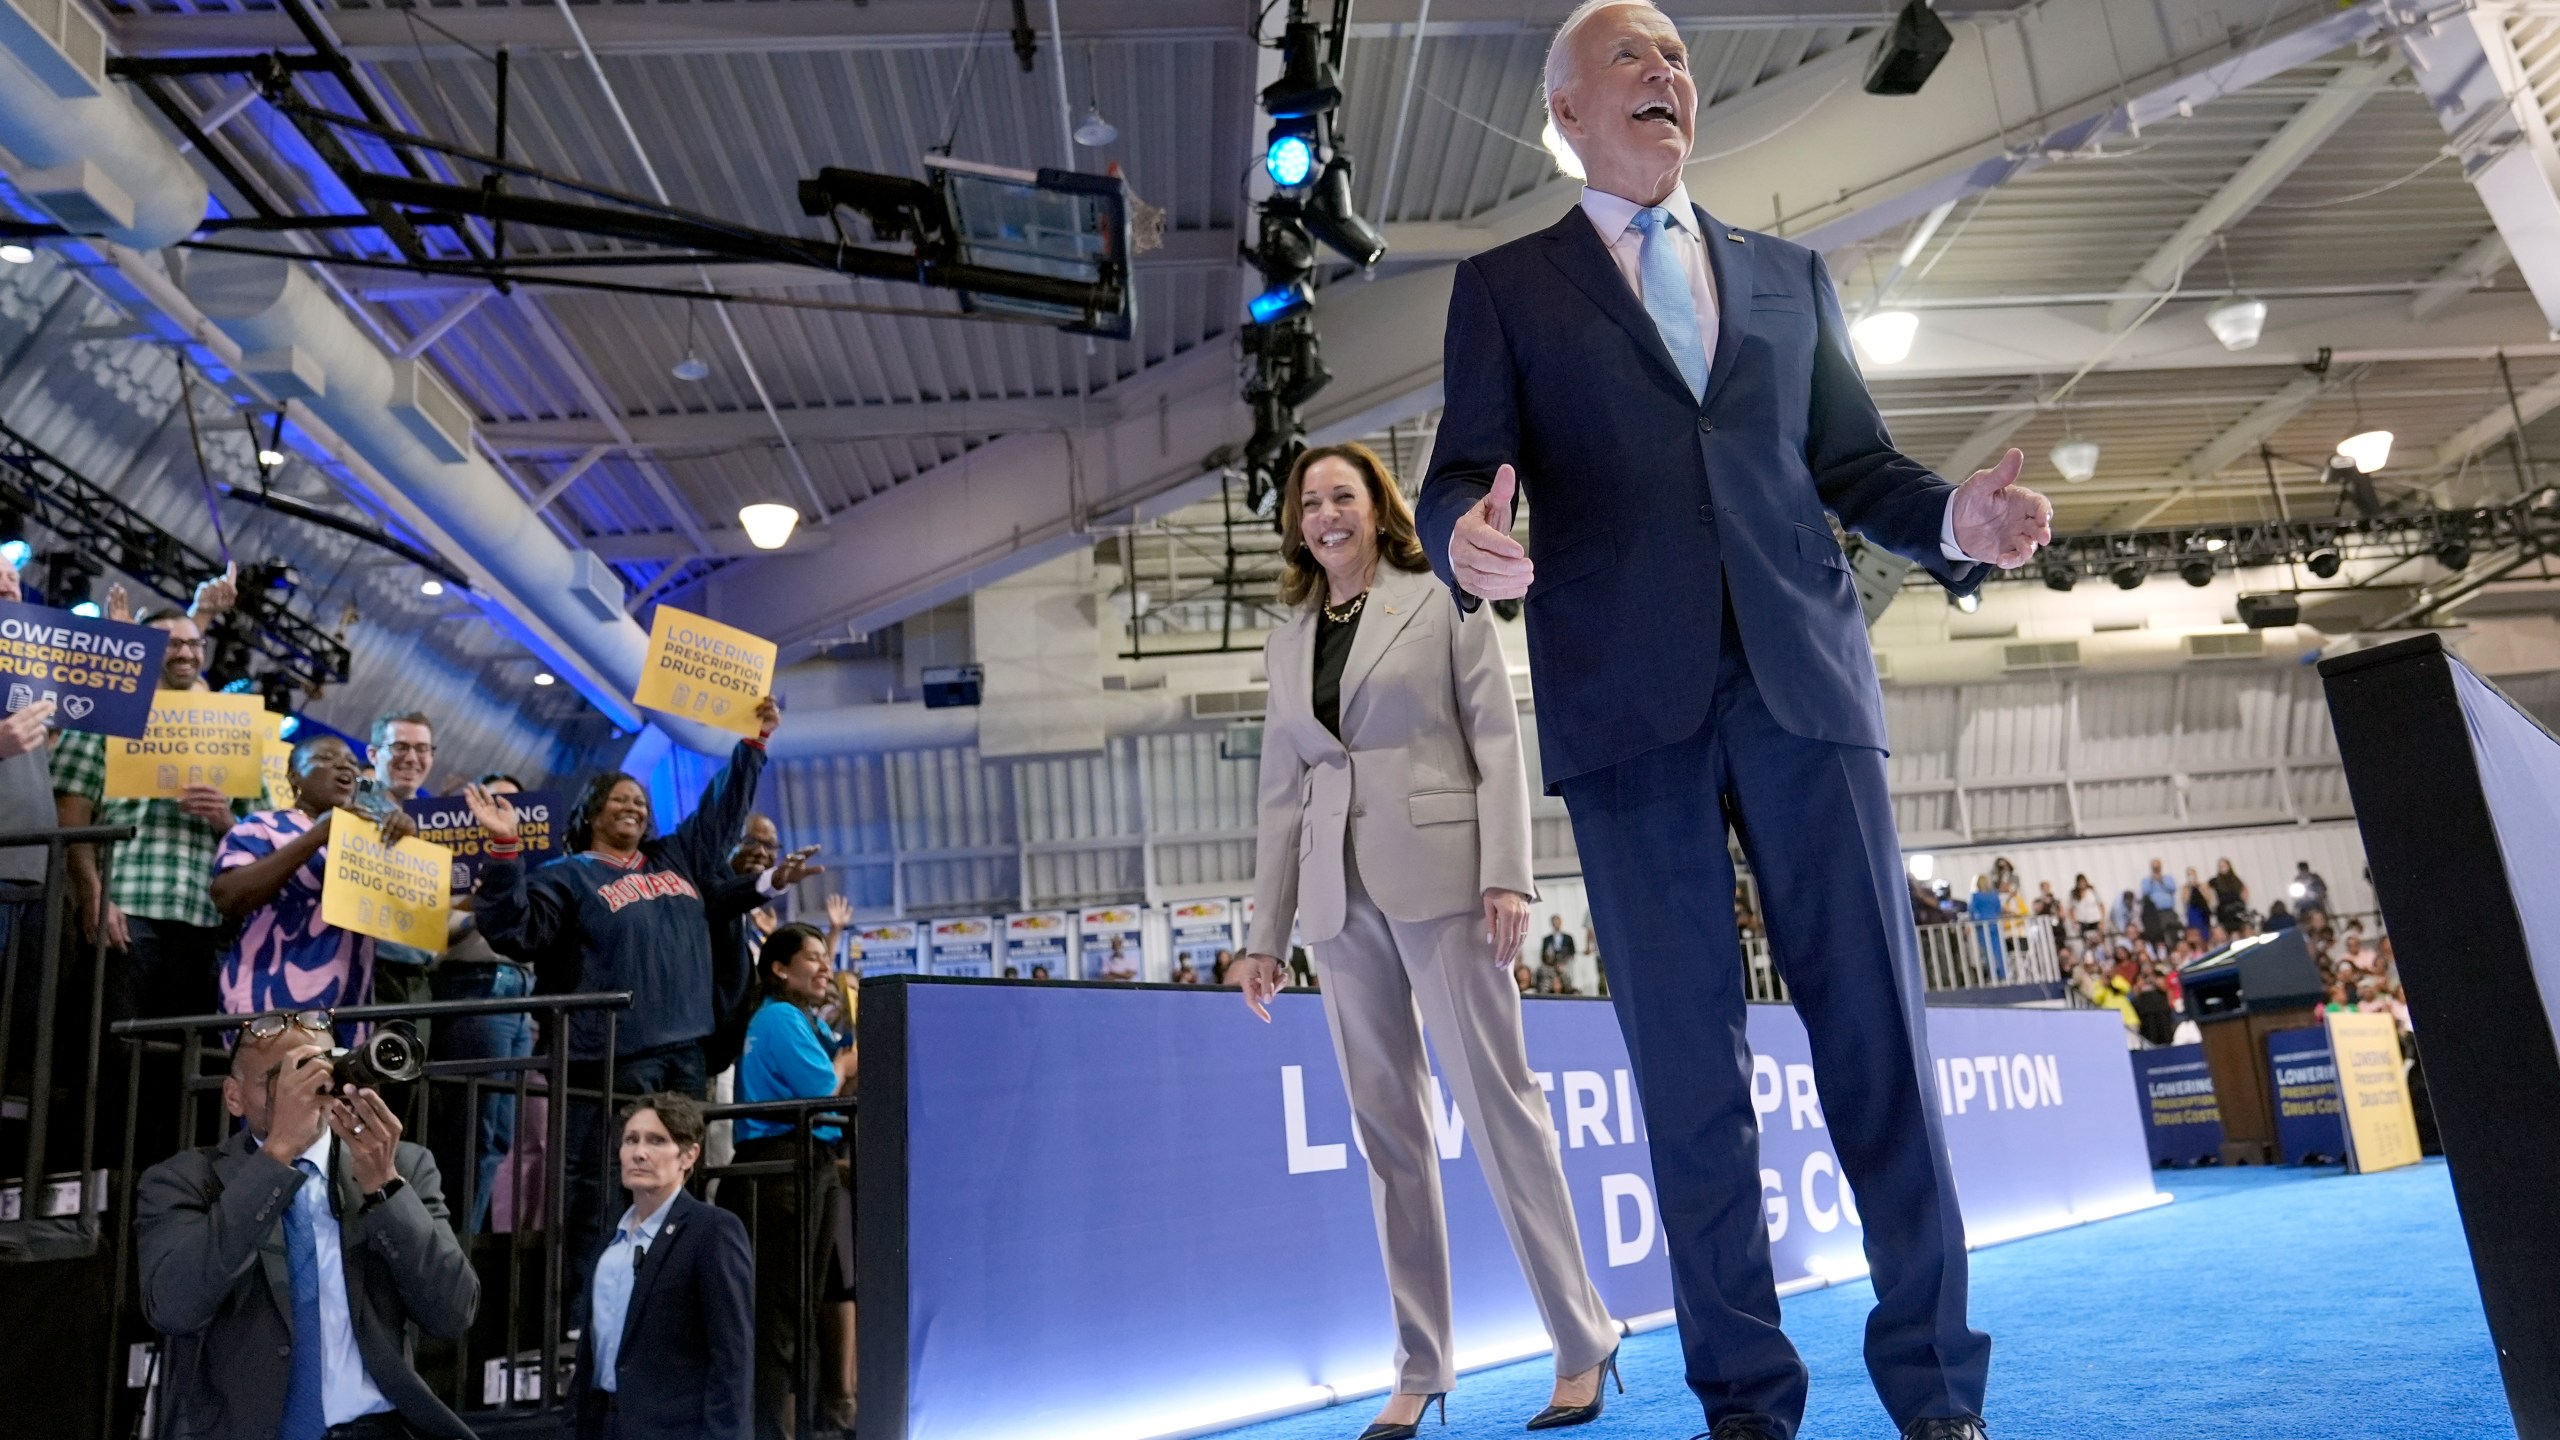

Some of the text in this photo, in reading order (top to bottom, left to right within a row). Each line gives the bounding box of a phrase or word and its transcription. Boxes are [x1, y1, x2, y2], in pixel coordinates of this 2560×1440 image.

[0, 638, 143, 677] RESCRIPTION
[1, 618, 146, 661] OWERING
[668, 625, 765, 670] LOWERING
[0, 655, 138, 694] RUG COSTS
[660, 655, 760, 697] DRUG COSTS
[664, 642, 762, 682] PRESCRIPTION
[145, 726, 251, 740] RESCRIPTION
[147, 709, 251, 726] OWERING
[126, 741, 251, 756] DRUG COSTS
[417, 804, 549, 829] LOWNG
[419, 822, 550, 841] PRESCRION
[340, 852, 438, 891] PRESCRIPTION
[342, 832, 439, 877] LOWERING
[338, 865, 437, 908] DRUG COSTS
[1750, 1053, 2063, 1132] PRIPTION
[2276, 1065, 2336, 1086] LOWERIN
[1601, 1169, 1789, 1267] DG
